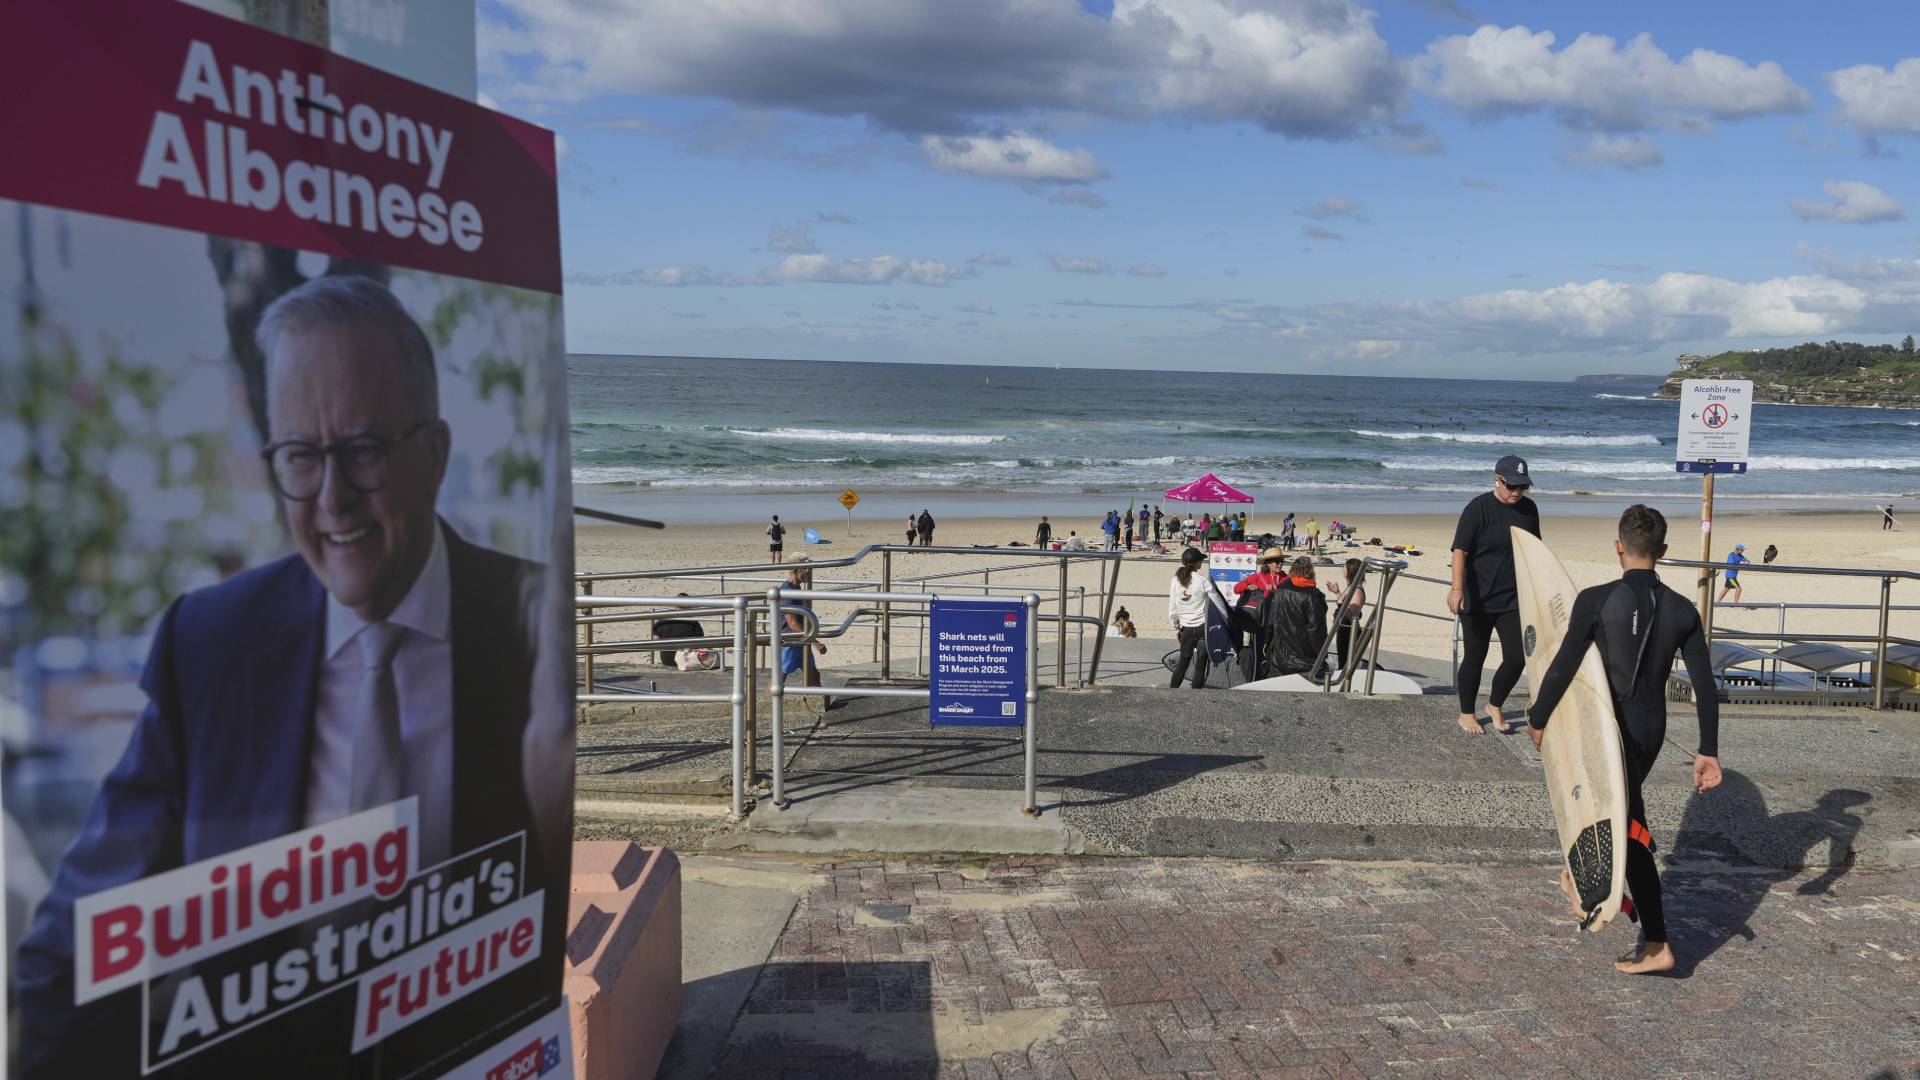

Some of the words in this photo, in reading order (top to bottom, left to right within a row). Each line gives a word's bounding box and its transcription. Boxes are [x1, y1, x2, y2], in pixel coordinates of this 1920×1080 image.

[175, 39, 453, 190] Anthony
[136, 110, 484, 252] Albanese
[939, 632, 966, 641] Shark
[967, 633, 987, 641] nets
[988, 633, 1004, 641] will
[939, 643, 950, 651] be
[952, 643, 990, 652] removed
[992, 644, 1014, 652] from
[939, 654, 956, 662] this
[957, 654, 985, 662] beach
[986, 655, 1008, 663] from
[939, 665, 949, 673] 31
[951, 665, 979, 673] March
[981, 666, 1008, 674] 2025.
[91, 824, 410, 985] Building
[158, 858, 515, 1056] Australia's
[365, 915, 535, 1039] Future
